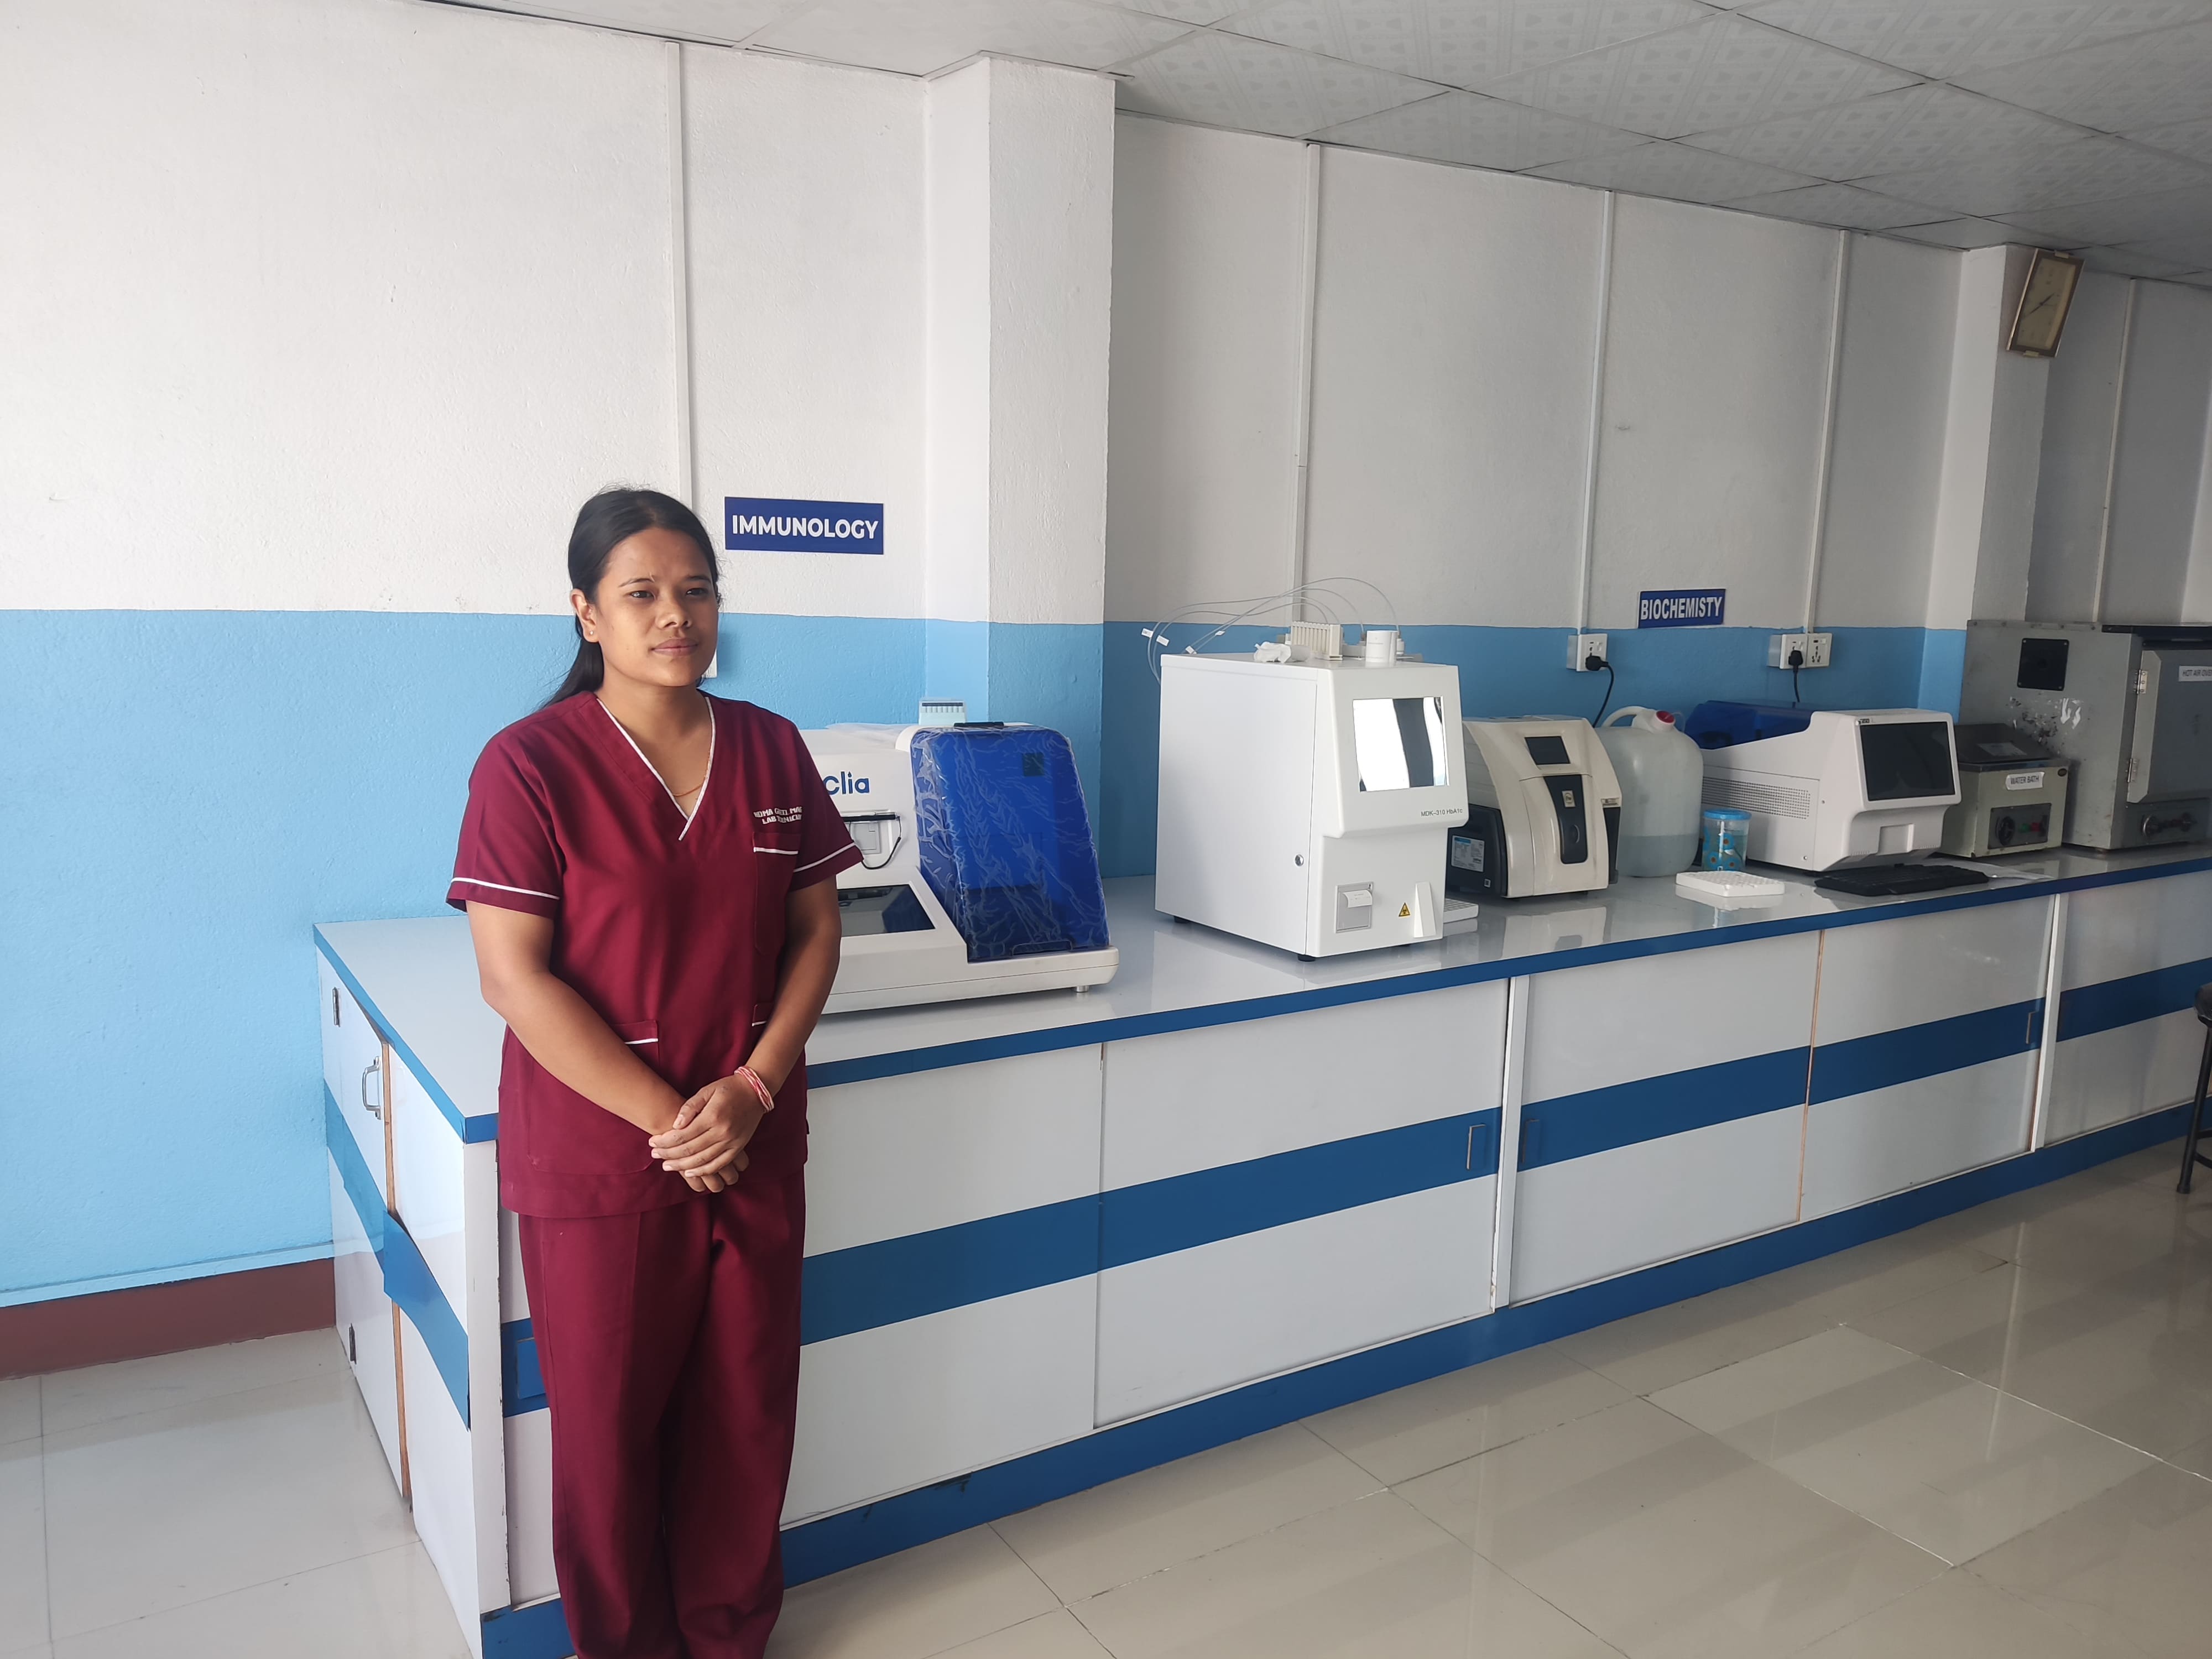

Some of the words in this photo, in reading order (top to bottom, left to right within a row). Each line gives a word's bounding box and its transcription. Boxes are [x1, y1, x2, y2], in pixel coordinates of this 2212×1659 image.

[732, 515, 879, 539] IMMUNOLOGY
[1640, 597, 1723, 620] BIOCHEMISTY
[2010, 776, 2026, 785] WATER
[762, 816, 776, 825] LAB
